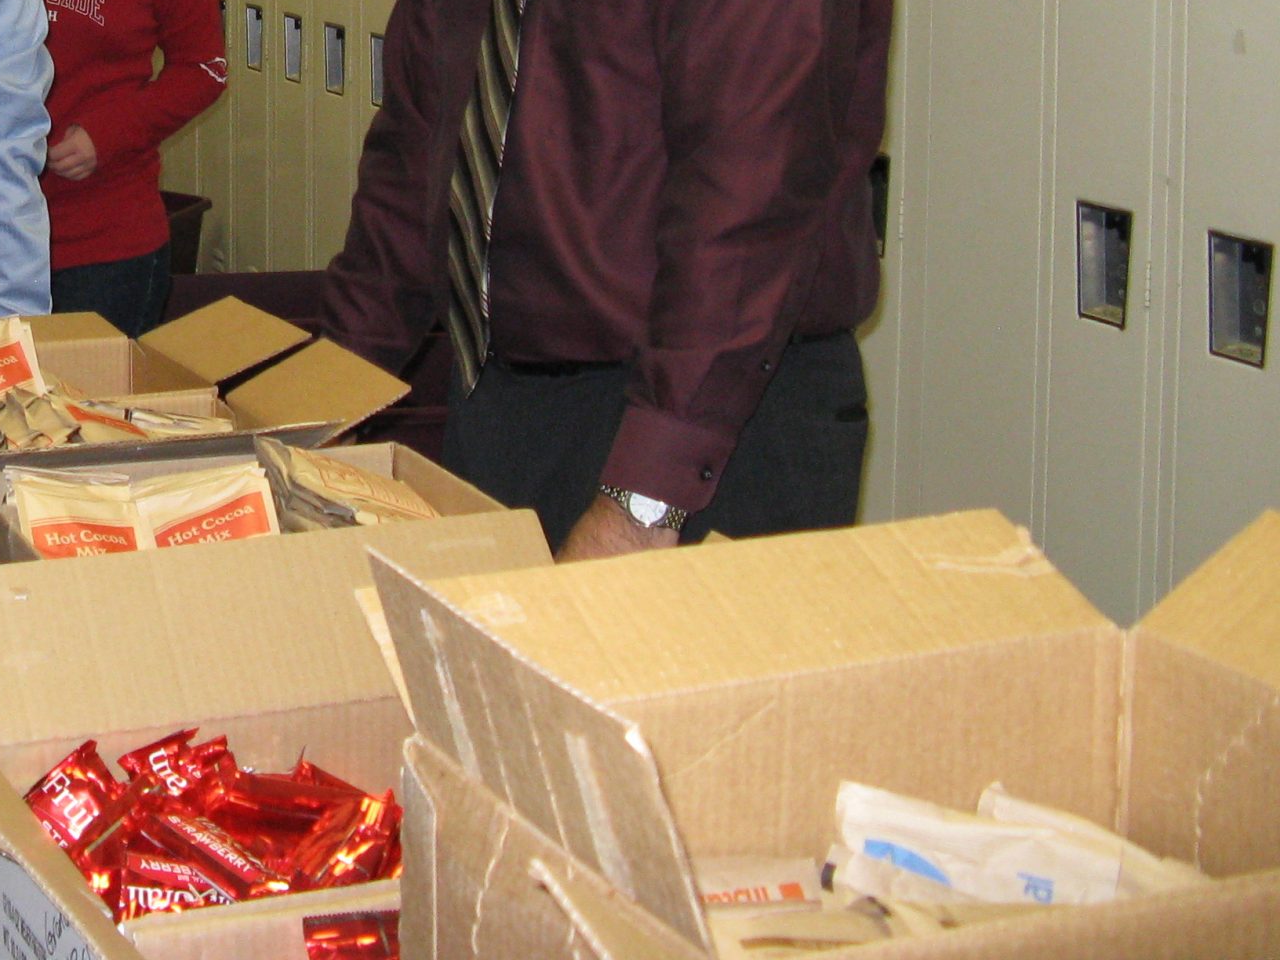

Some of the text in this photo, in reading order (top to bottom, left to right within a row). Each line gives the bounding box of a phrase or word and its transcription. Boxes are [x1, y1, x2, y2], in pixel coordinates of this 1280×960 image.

[167, 504, 255, 547] Hot Cocoa
[43, 529, 128, 547] Hot Cocoa
[198, 529, 233, 547] Mix
[76, 546, 108, 558] Mix
[167, 814, 255, 873] STRAWBERRY
